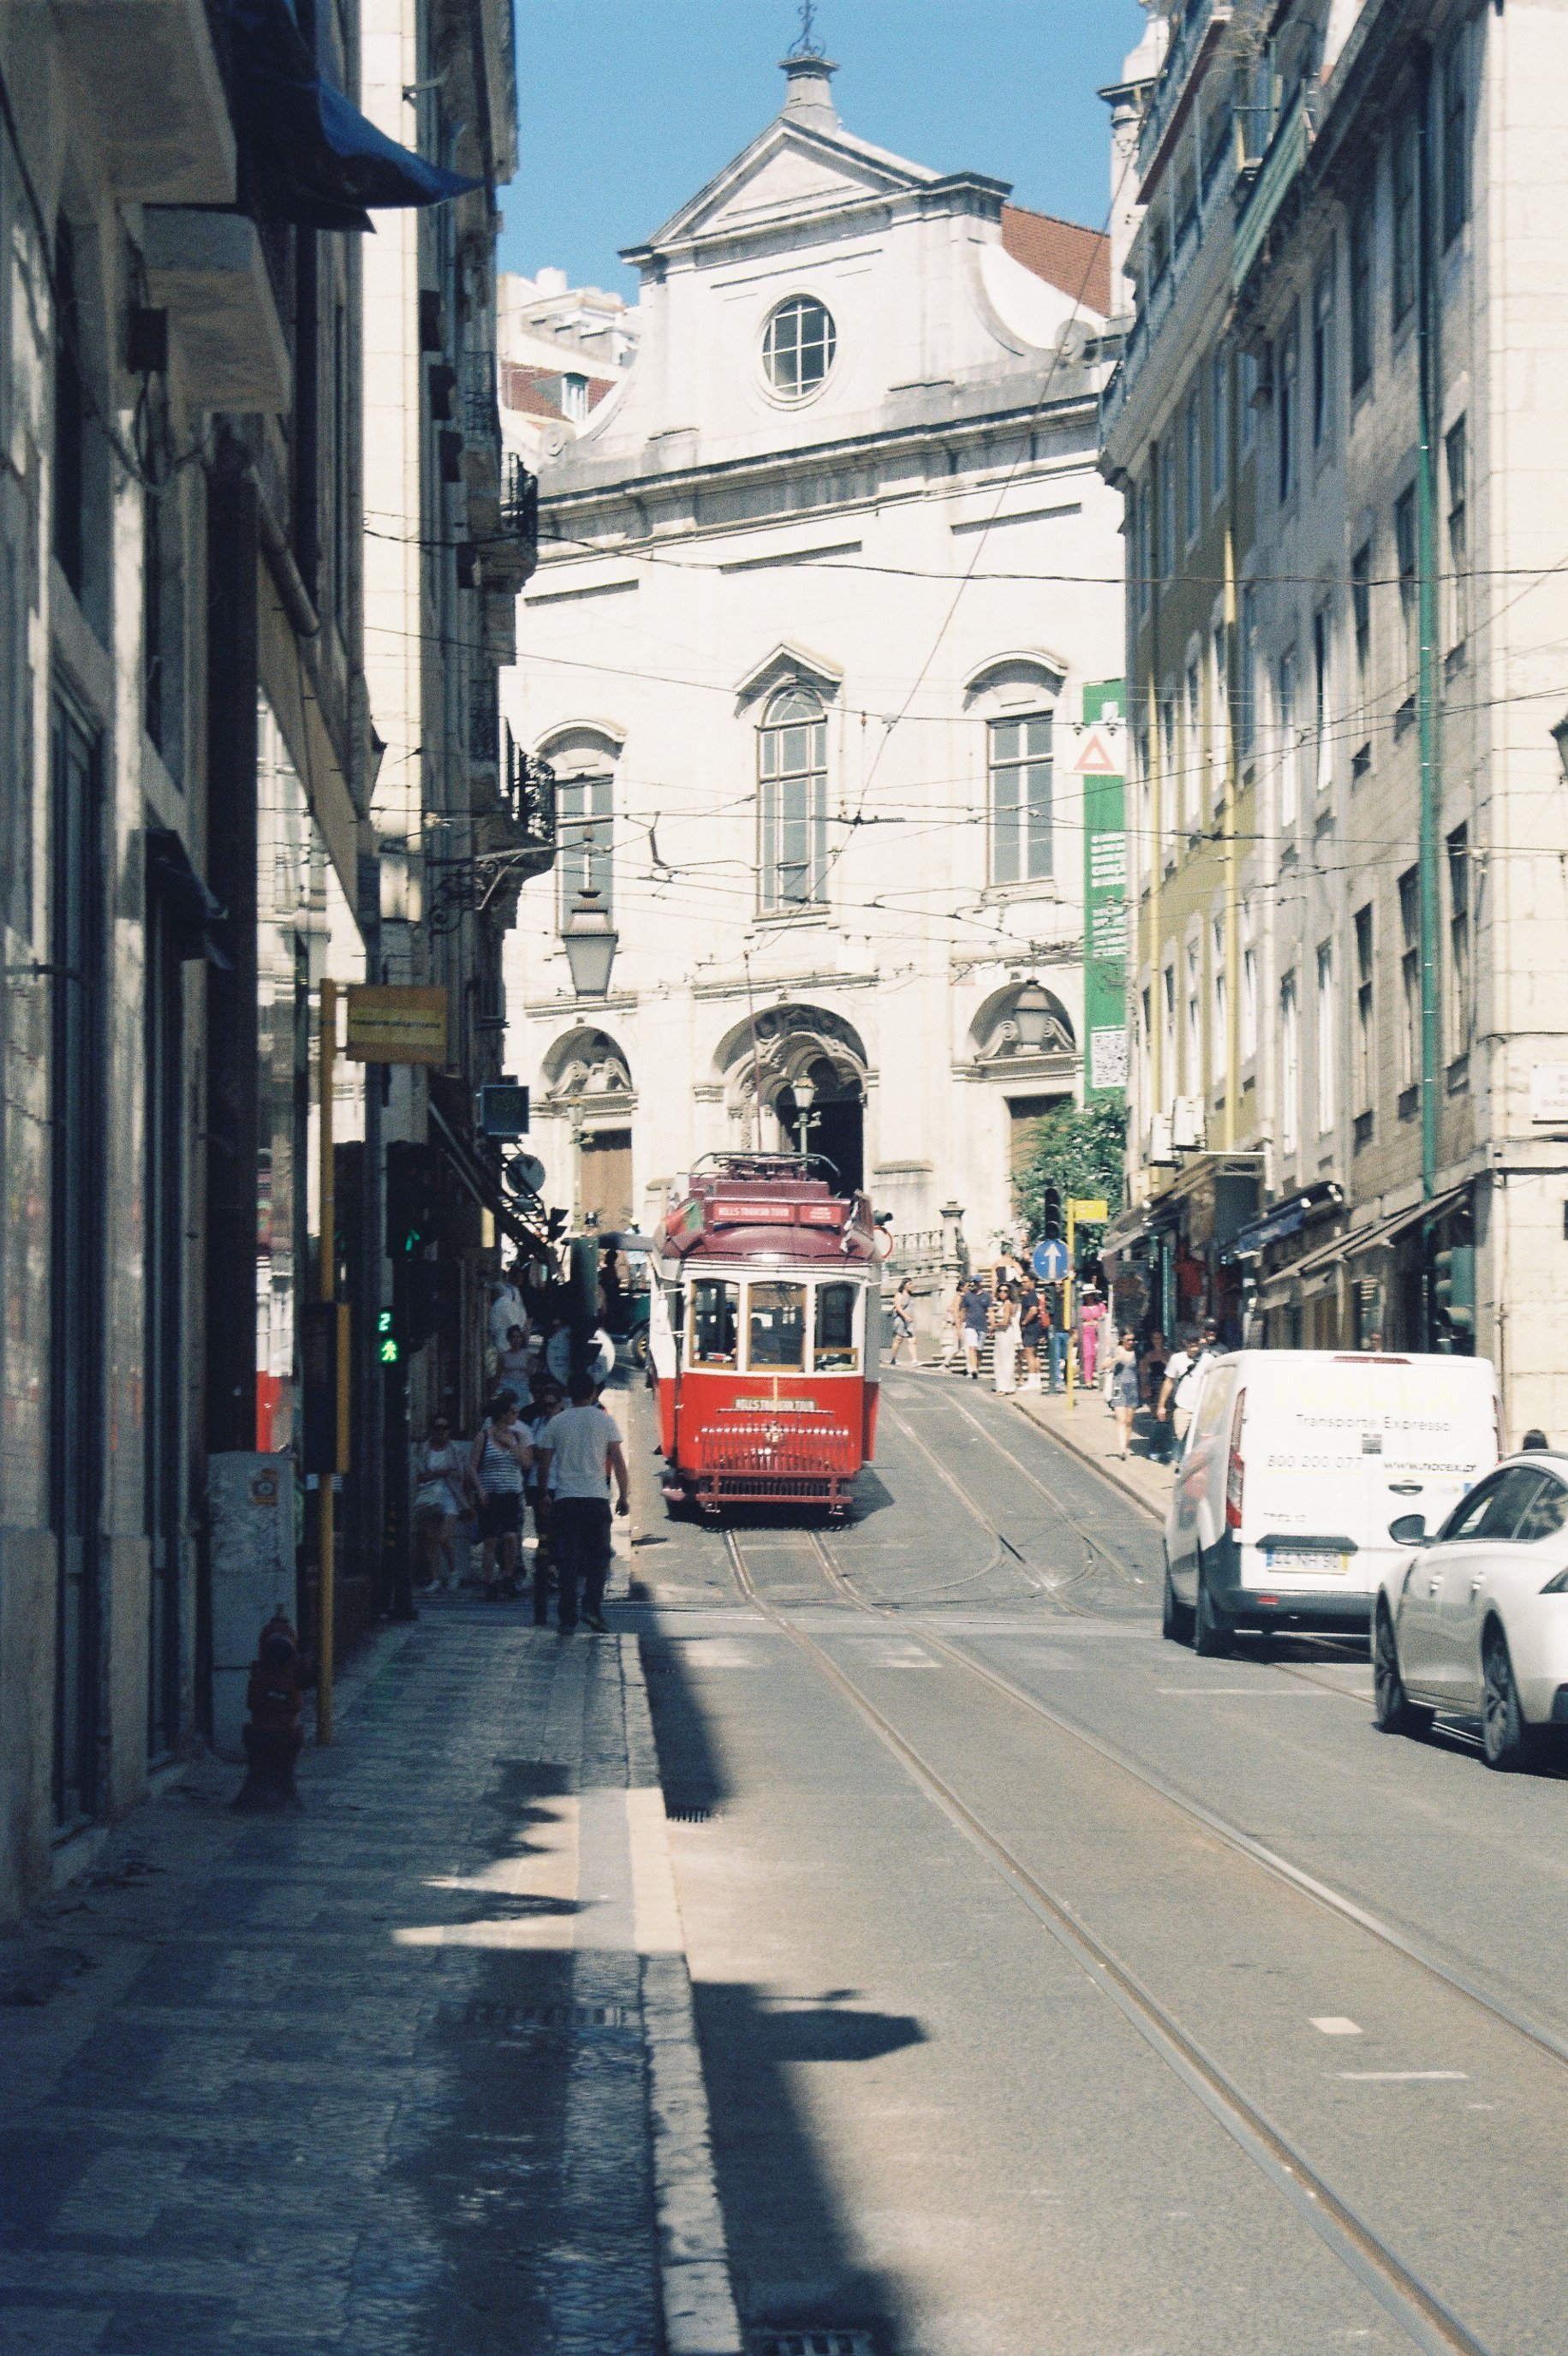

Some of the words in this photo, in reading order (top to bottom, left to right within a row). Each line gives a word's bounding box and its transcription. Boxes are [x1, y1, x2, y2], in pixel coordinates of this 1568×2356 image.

[379, 1313, 391, 1331] 2
[1296, 1413, 1377, 1430] Transporte
[1384, 1416, 1452, 1432] Expresso
[1268, 1454, 1295, 1467] 800
[1302, 1455, 1329, 1468] 200
[1336, 1456, 1364, 1469] 077
